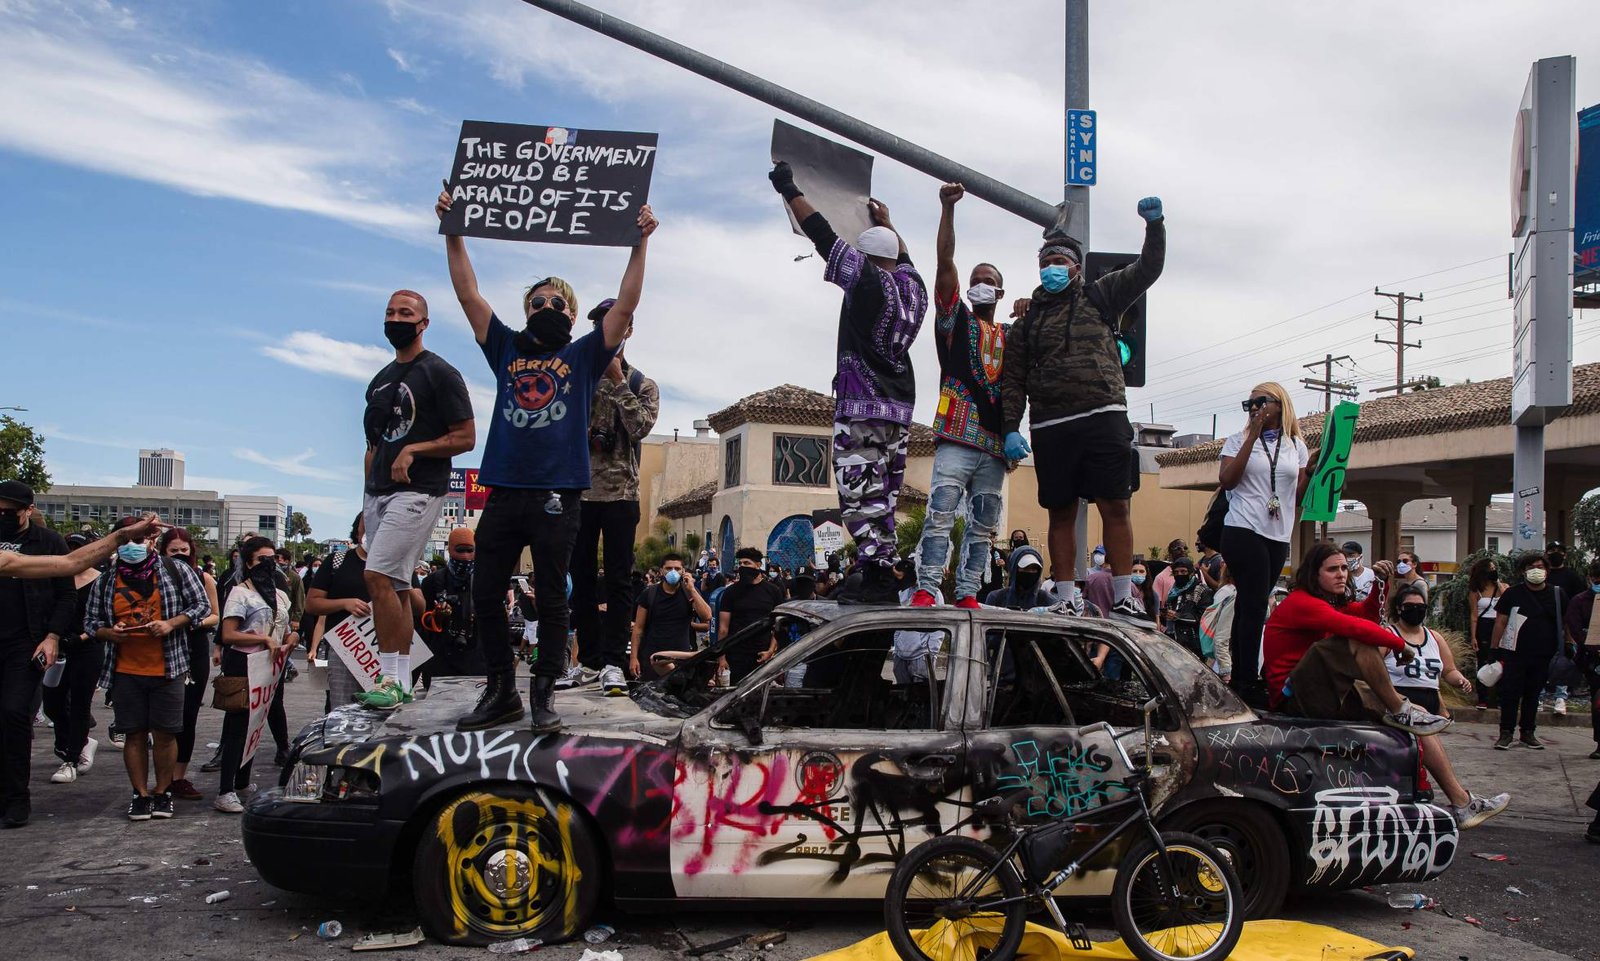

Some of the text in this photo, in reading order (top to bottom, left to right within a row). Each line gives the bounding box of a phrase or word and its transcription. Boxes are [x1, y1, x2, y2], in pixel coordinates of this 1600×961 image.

[461, 137, 656, 168] THE GOVERNMENT
[1079, 114, 1093, 180] SYNC
[460, 162, 589, 183] SHOULD BE
[452, 184, 632, 211] AFRAID OF ITS
[464, 204, 590, 235] PEOPLE
[503, 399, 567, 429] 2020
[450, 481, 466, 489] CLE
[1404, 657, 1442, 680] 85
